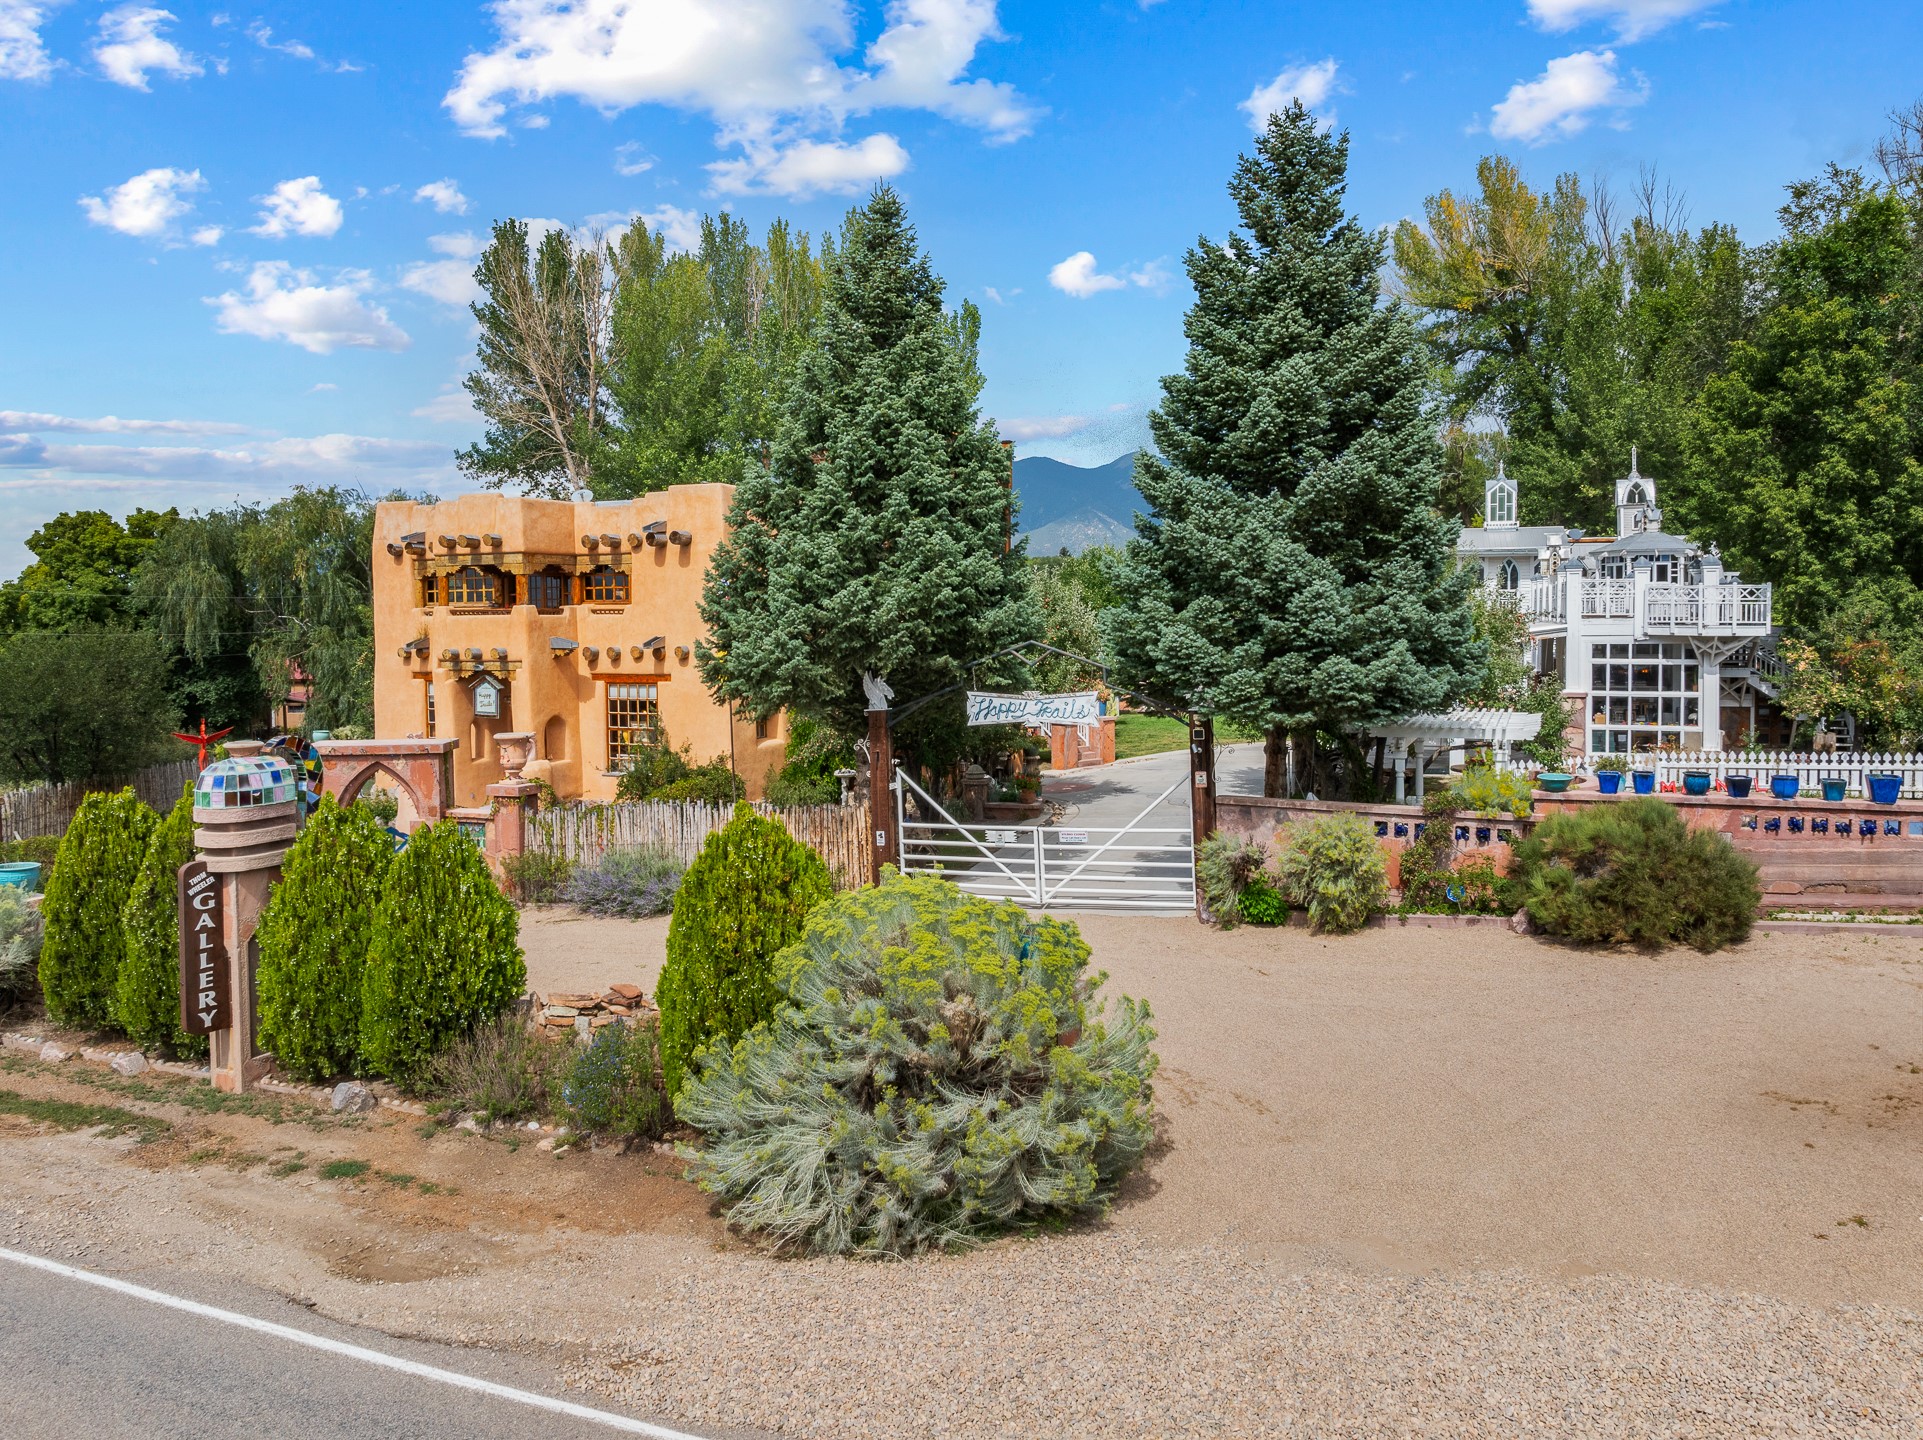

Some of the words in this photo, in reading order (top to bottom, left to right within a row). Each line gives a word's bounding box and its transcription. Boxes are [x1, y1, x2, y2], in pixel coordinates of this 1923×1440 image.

[974, 696, 1028, 721] Happy
[1034, 698, 1091, 720] Trails
[187, 875, 216, 897] WHEELER
[188, 871, 207, 886] THOM
[192, 891, 218, 1029] GALLERY
